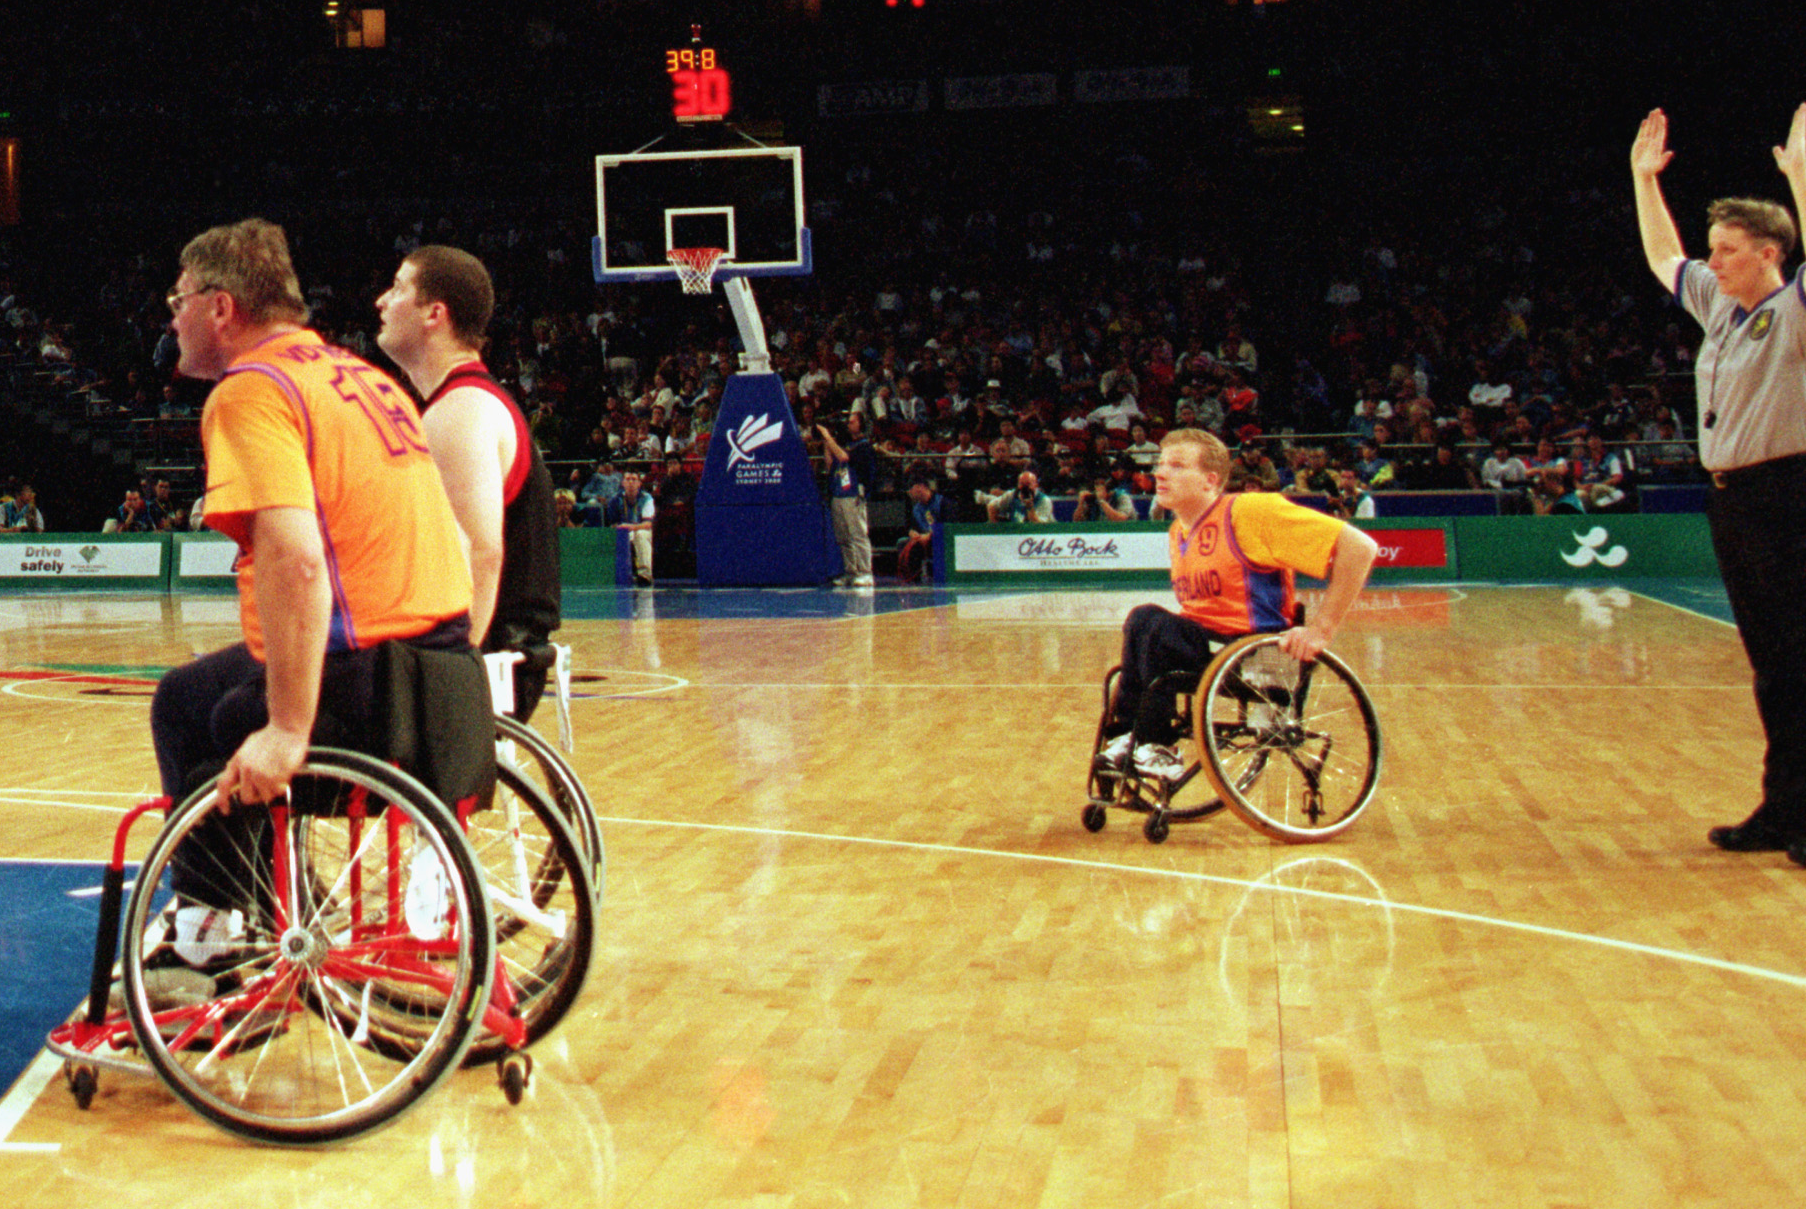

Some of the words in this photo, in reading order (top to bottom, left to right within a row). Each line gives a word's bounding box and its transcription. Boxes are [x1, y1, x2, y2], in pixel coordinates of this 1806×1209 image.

[673, 70, 730, 116] 30
[1018, 537, 1063, 557] Otto
[1067, 537, 1120, 558] Bock
[1199, 523, 1219, 556] 9
[25, 546, 62, 557] Drive
[21, 559, 64, 574] safely
